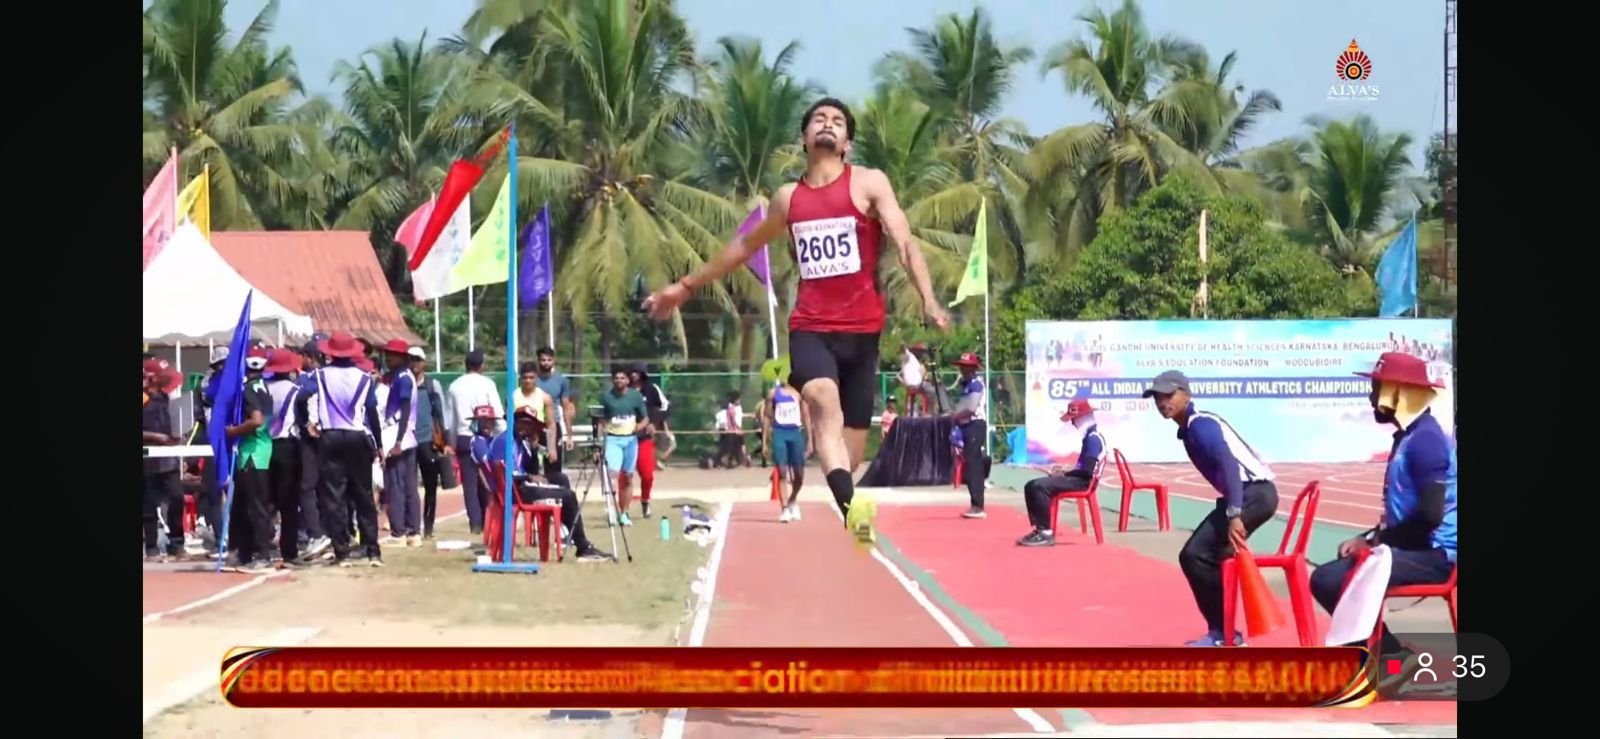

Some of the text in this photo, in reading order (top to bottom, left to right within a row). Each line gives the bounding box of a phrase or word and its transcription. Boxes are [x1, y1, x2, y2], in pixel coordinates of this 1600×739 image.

[798, 232, 851, 264] 2605
[806, 261, 849, 276] ALVA'S
[1144, 343, 1194, 352] UNIVERSITY
[1210, 343, 1243, 351] HEALTH
[1288, 343, 1338, 351] KARNATAKA
[1216, 359, 1269, 367] FOUNDATION
[1091, 382, 1111, 395] ALL
[1113, 382, 1143, 395] INDIA
[1188, 381, 1242, 394] NIVERSITY
[1245, 381, 1302, 394] ATHLETICS
[1305, 381, 1373, 394] CHAMPIONSH
